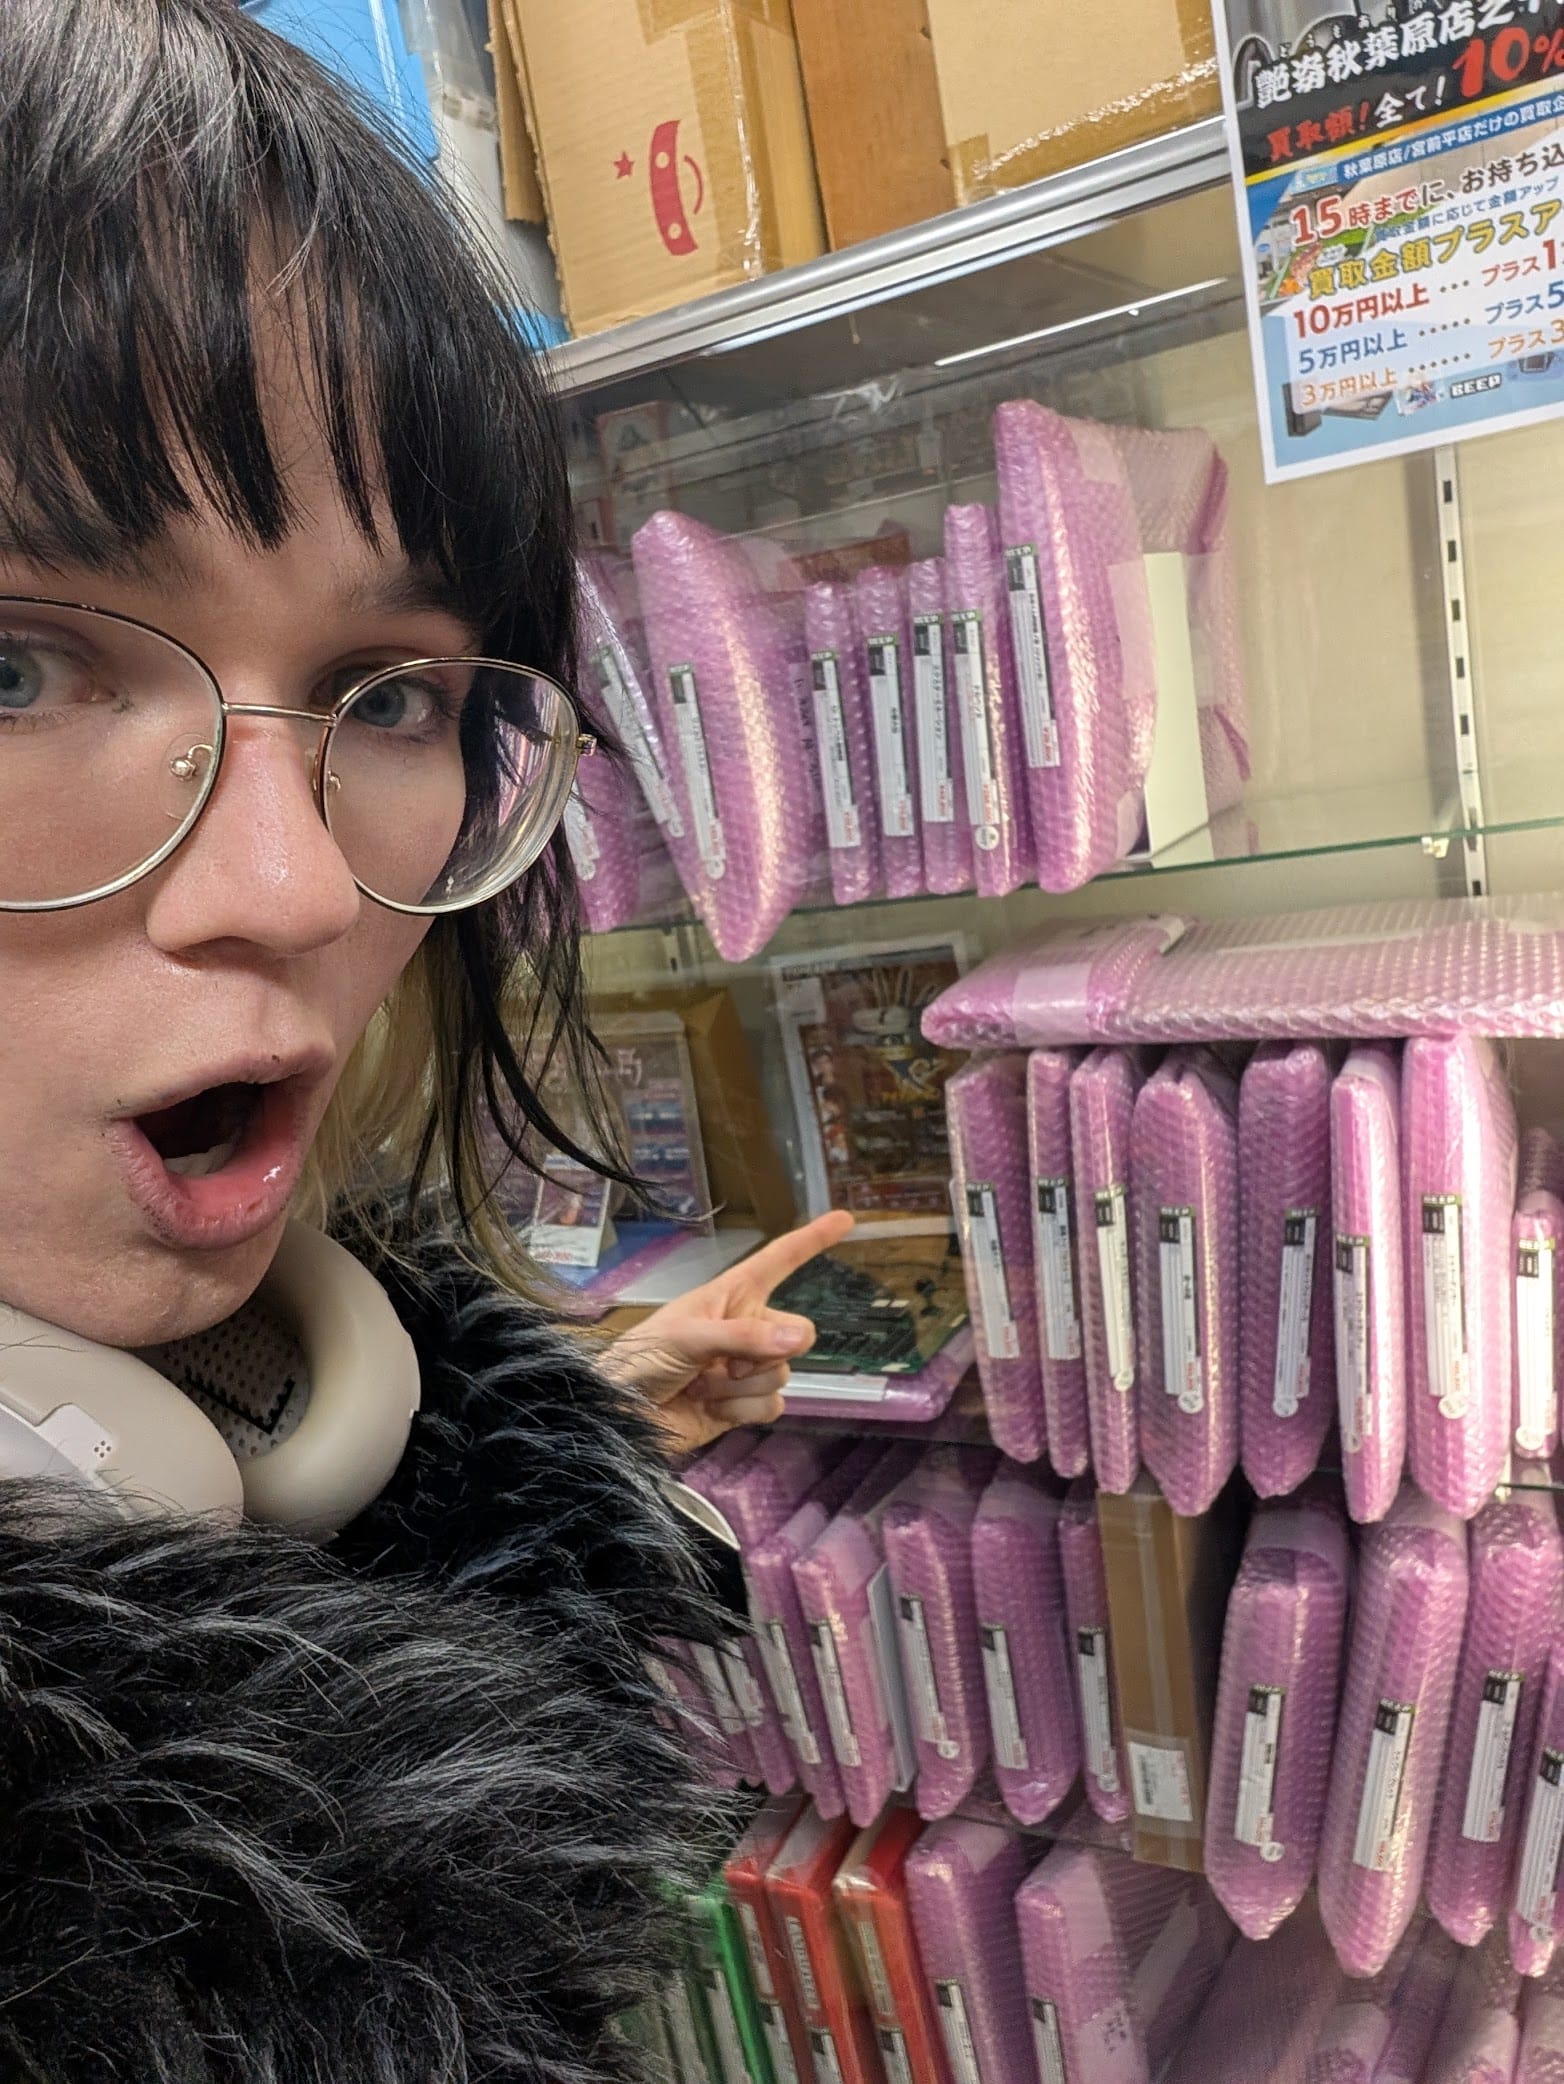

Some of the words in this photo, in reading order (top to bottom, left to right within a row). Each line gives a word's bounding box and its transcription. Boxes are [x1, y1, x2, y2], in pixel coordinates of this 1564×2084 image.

[1294, 284, 1430, 338] 10万円以上
[1298, 329, 1408, 374] 5万円以上
[1301, 367, 1398, 407] 3万円以上
